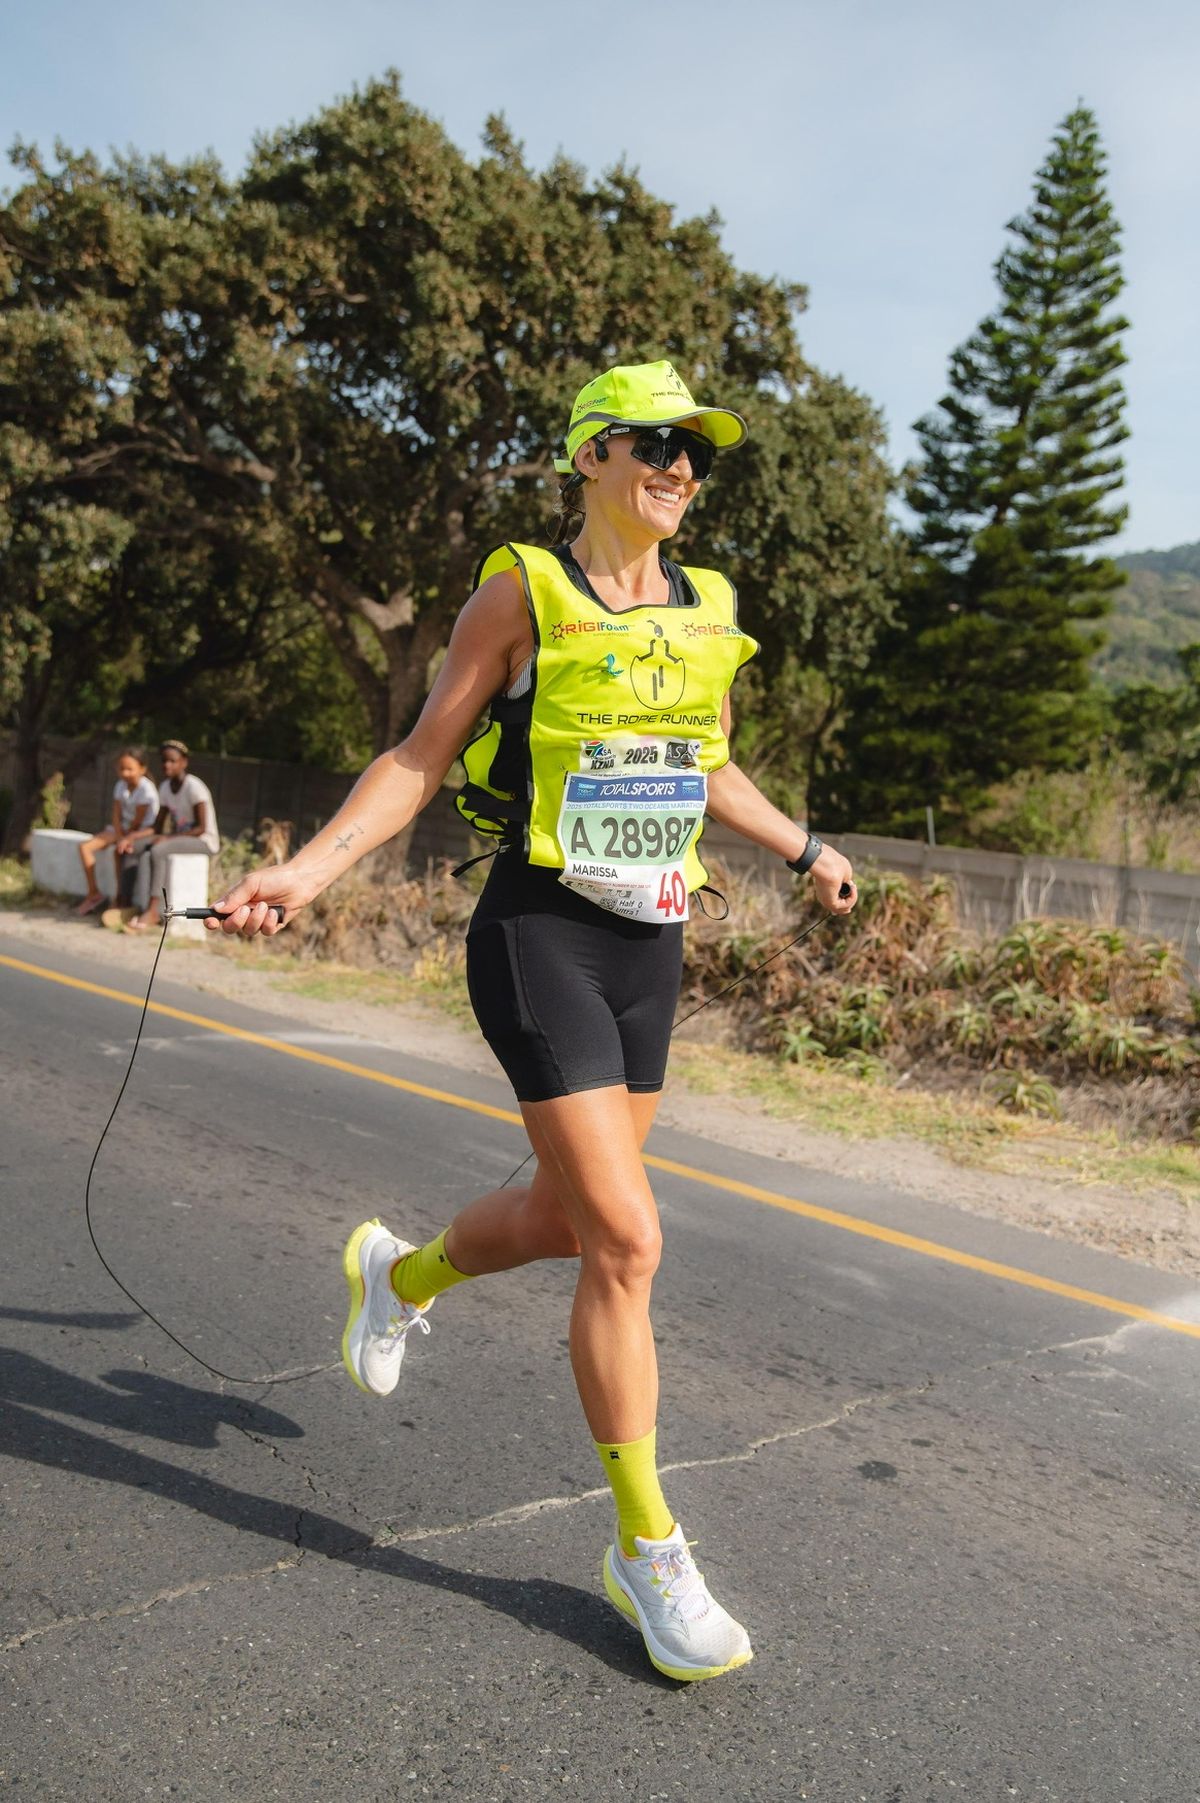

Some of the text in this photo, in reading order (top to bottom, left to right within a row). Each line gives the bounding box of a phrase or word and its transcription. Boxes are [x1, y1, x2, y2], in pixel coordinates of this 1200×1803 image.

[577, 713, 717, 726] THE ROPE RUNNER
[623, 746, 658, 765] 2025
[666, 744, 692, 760] ASA
[600, 782, 677, 797] TOTALSPORTS
[571, 817, 697, 858] A 28987
[572, 863, 619, 879] MARISSA
[656, 870, 686, 917] 40
[619, 899, 634, 907] Half
